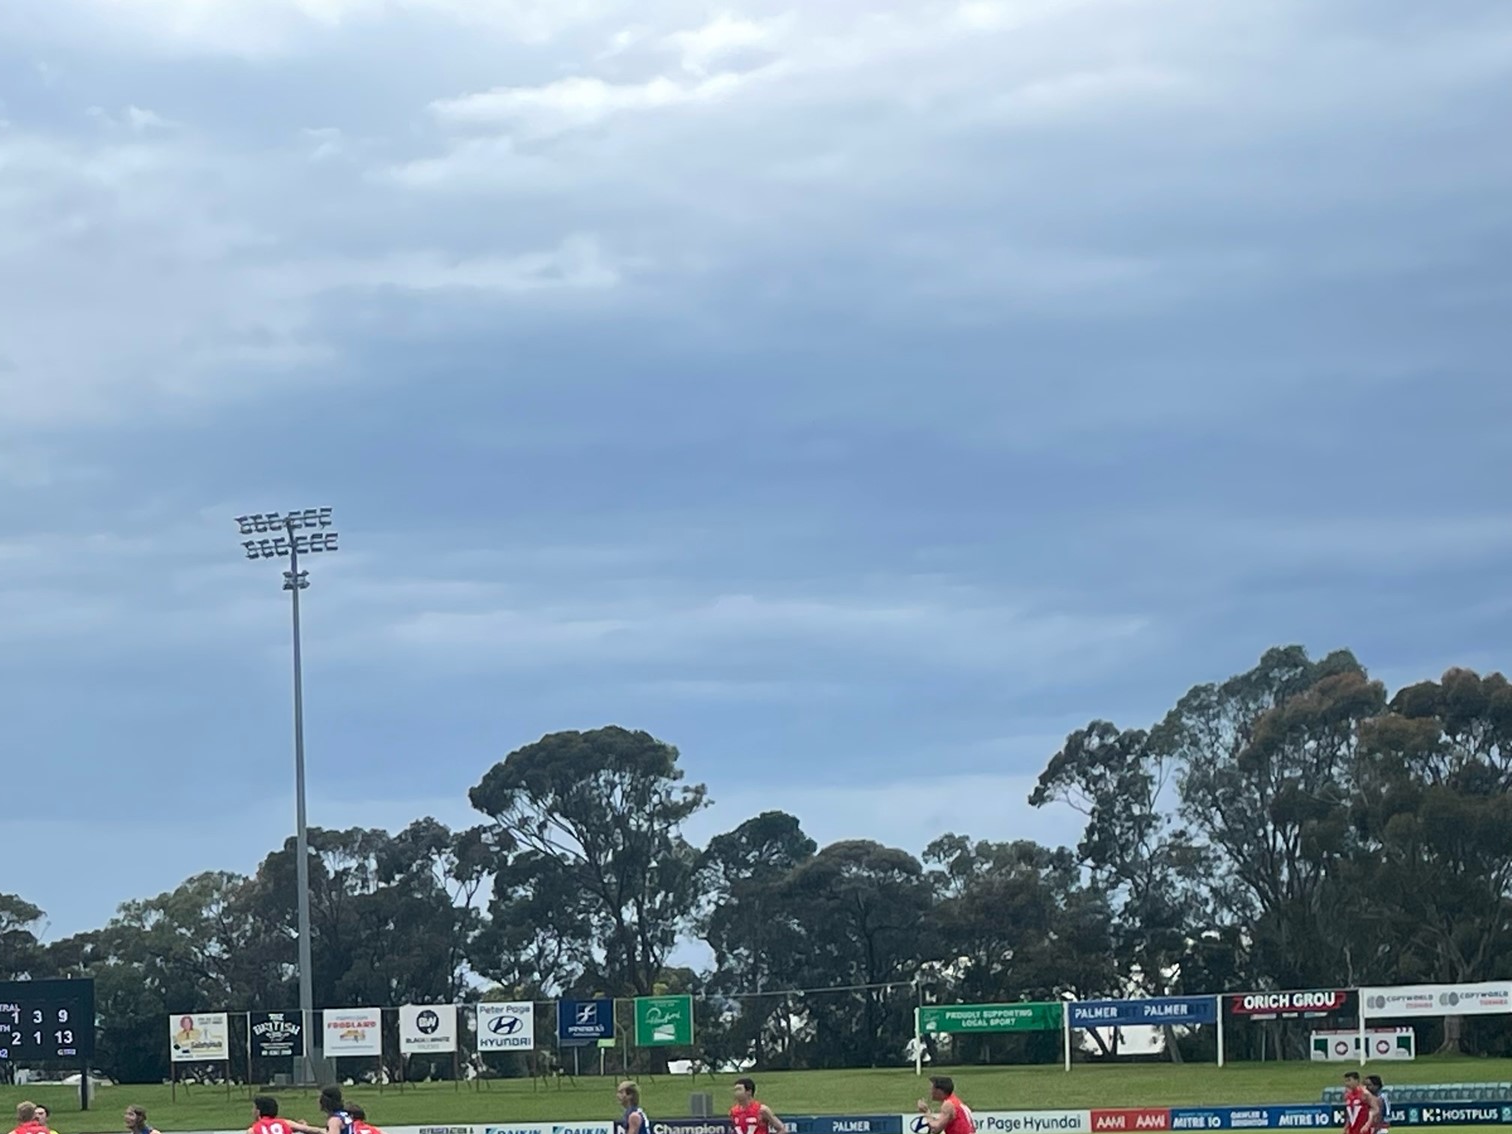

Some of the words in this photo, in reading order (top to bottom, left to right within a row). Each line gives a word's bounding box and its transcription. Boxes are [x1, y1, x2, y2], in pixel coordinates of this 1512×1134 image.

[946, 1011, 981, 1019] PROUDLY
[983, 1009, 1033, 1017] SUPPORTING
[1075, 1007, 1118, 1019] PALMER
[1144, 1004, 1188, 1016] PALMER
[11, 1011, 19, 1025] 1
[33, 1010, 43, 1024] 3
[58, 1009, 68, 1023] 9
[962, 1019, 988, 1027] LOCAL
[990, 1018, 1016, 1026] SPORT
[11, 1032, 21, 1045] 2
[33, 1031, 41, 1045] 1
[54, 1030, 73, 1044] 13
[832, 1121, 870, 1132] PALMER
[987, 1117, 1021, 1132] Page
[1023, 1115, 1081, 1131] Hyundai
[1097, 1117, 1125, 1129] AAMI
[1136, 1115, 1165, 1128] AAMI
[1173, 1117, 1206, 1128] MITRE
[1208, 1116, 1221, 1127] 10
[1279, 1115, 1314, 1126] MITRE
